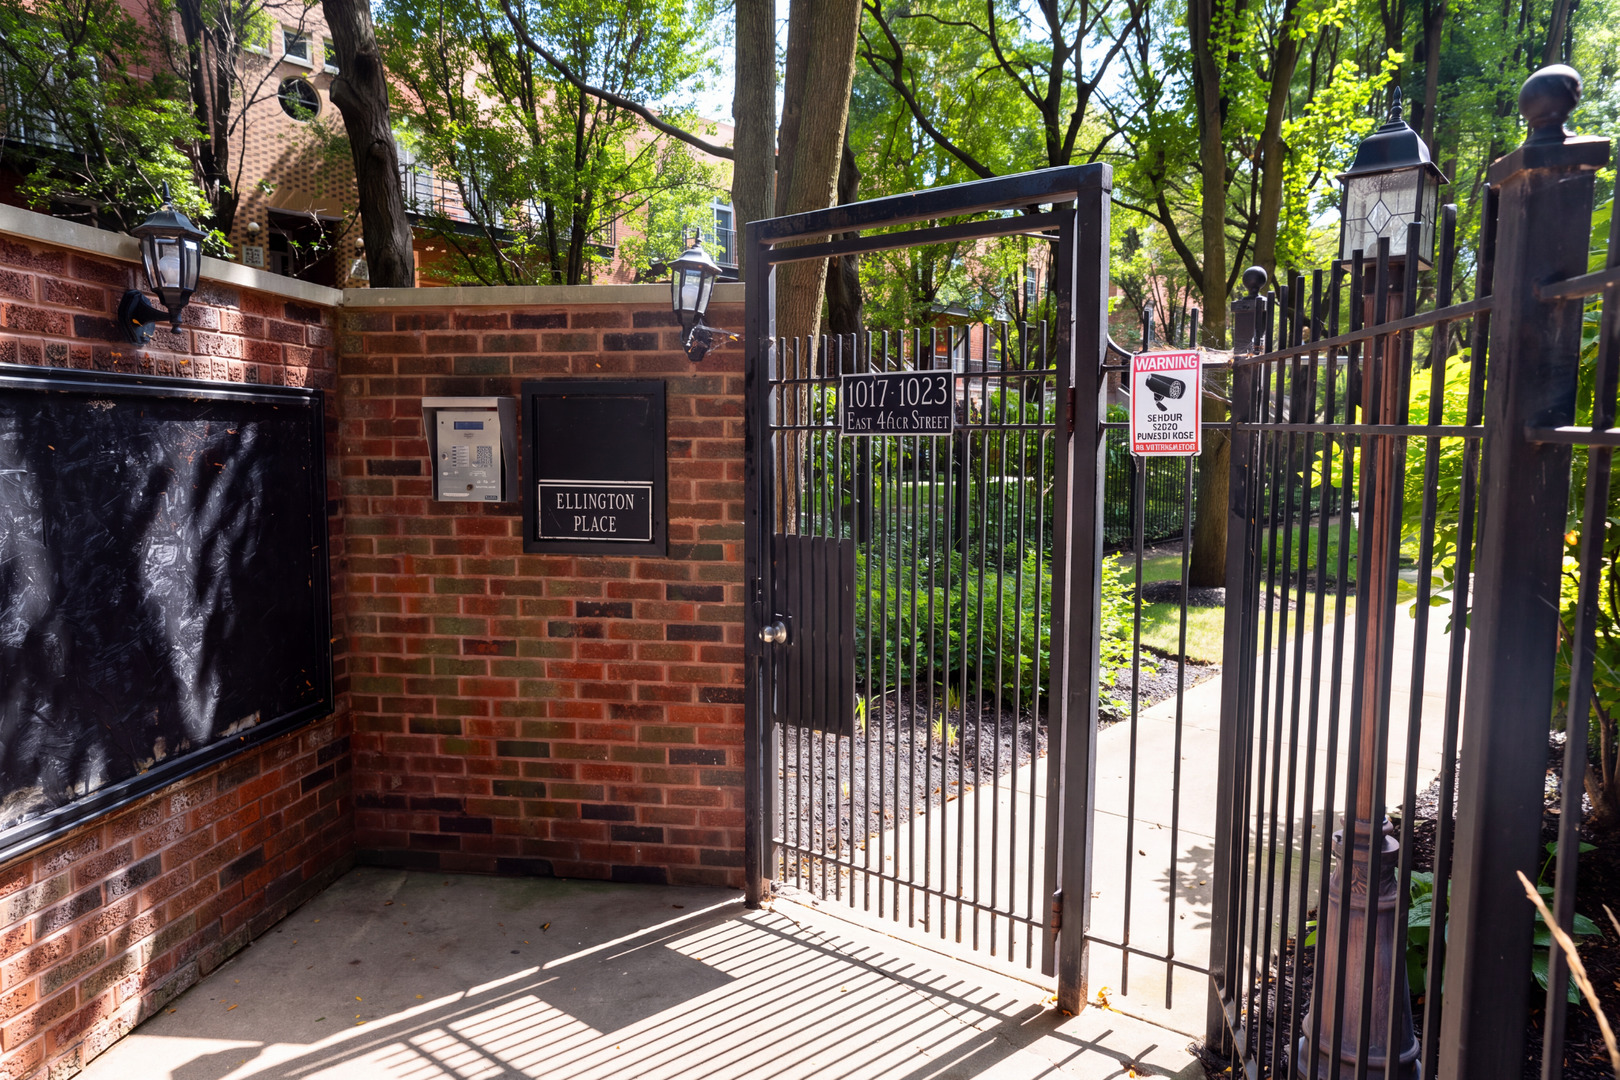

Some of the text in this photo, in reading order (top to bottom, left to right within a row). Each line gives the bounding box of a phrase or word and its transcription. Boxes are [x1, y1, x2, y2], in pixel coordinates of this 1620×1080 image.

[1136, 355, 1197, 371] WARNING
[556, 492, 635, 510] ELLINGTON
[573, 515, 617, 532] PLACE
